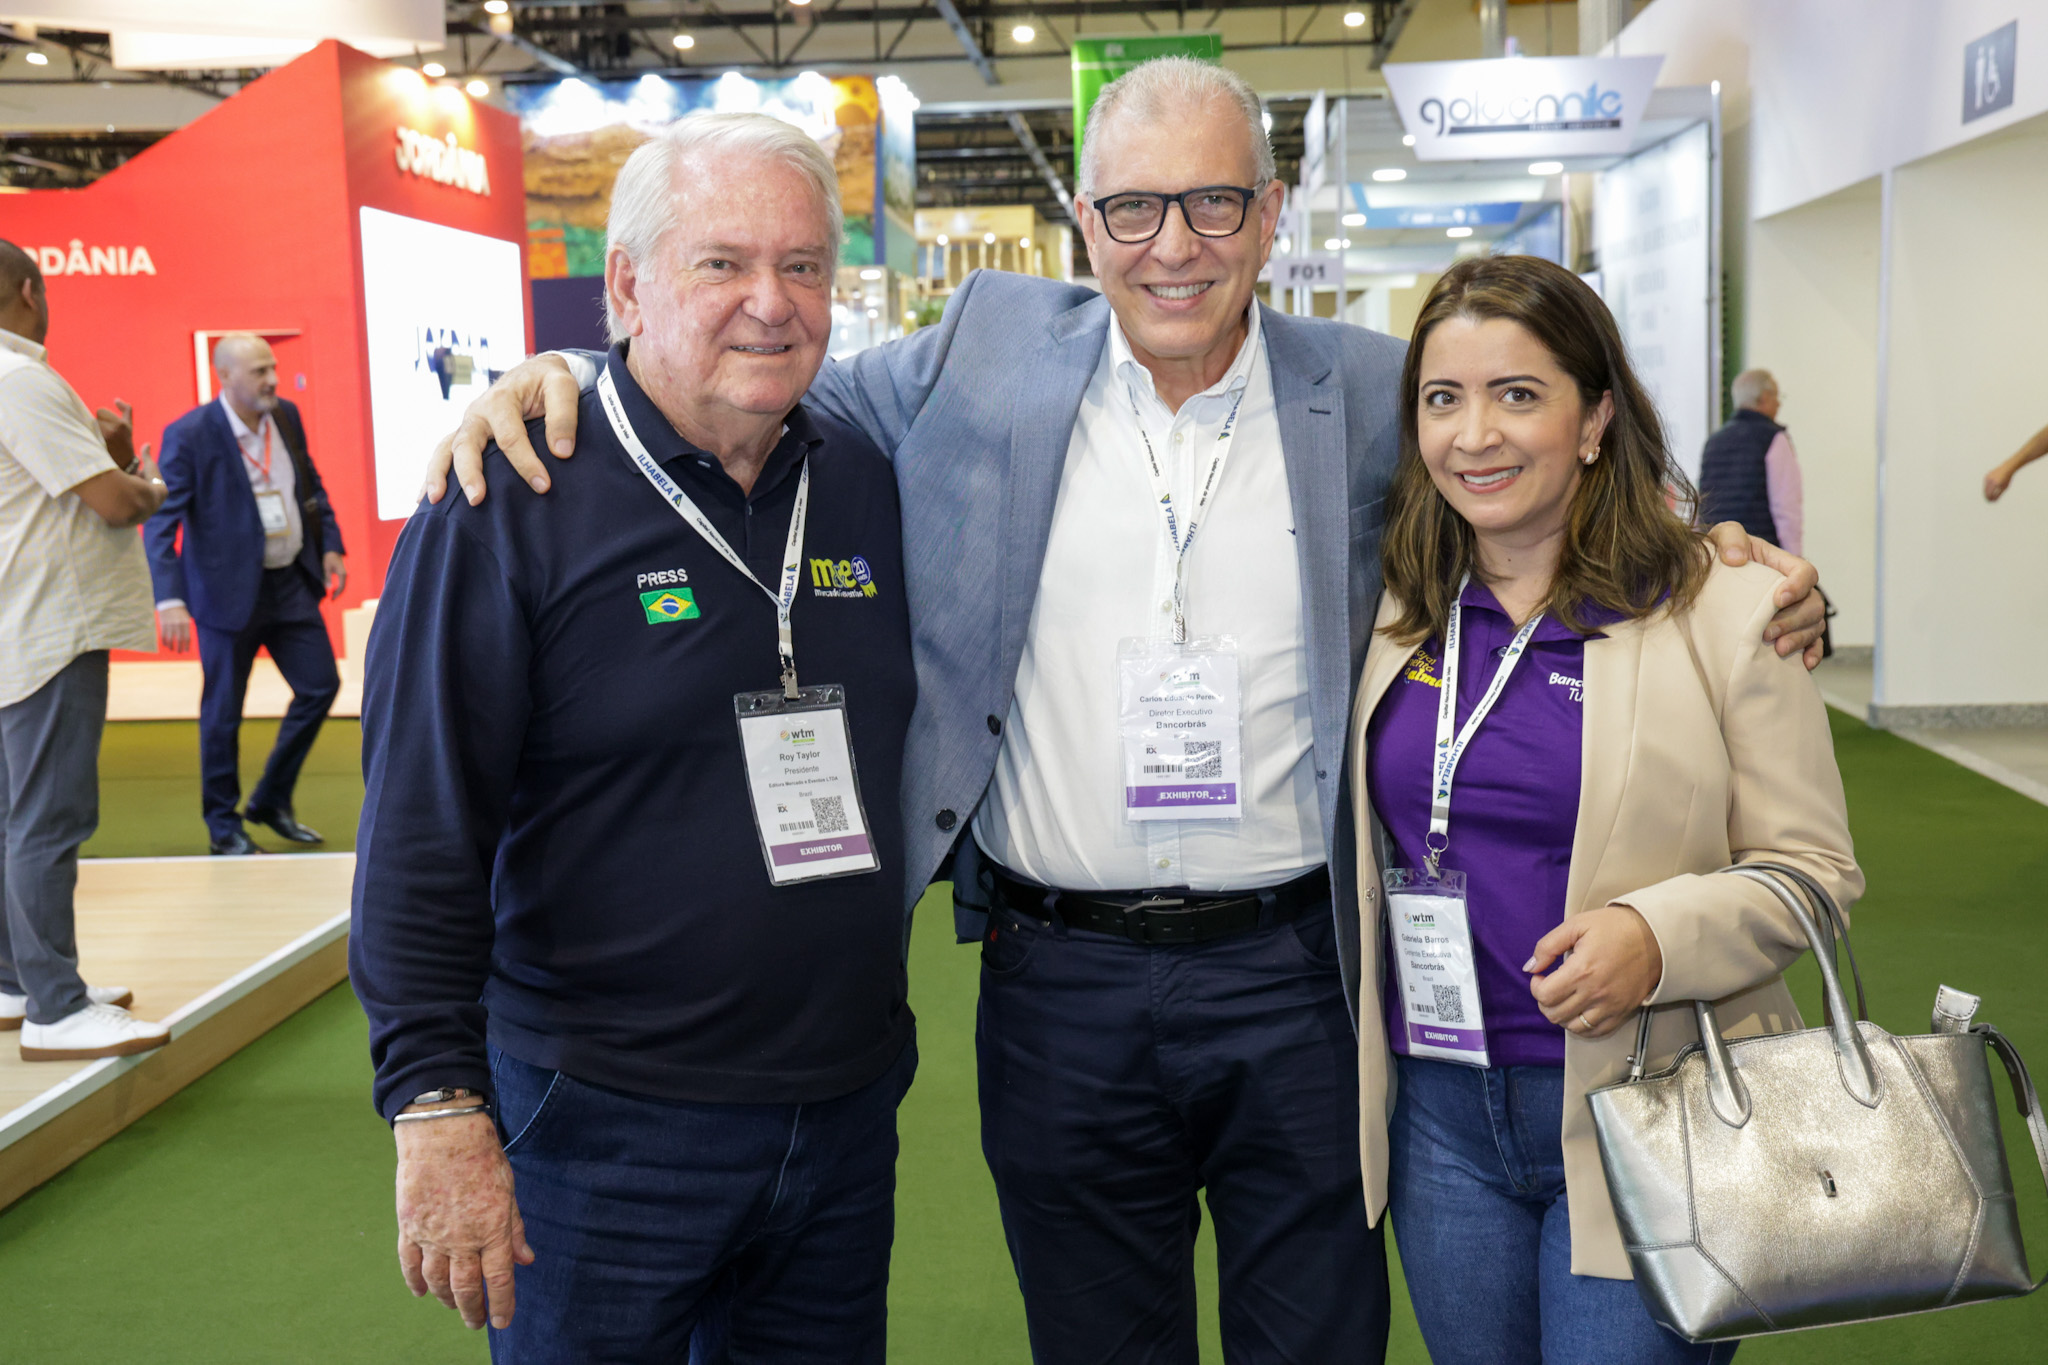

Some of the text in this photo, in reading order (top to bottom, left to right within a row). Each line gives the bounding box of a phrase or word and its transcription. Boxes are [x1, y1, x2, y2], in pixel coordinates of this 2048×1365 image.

[1289, 264, 1326, 280] F01
[637, 453, 674, 496] ILHABELA
[1165, 506, 1180, 552] ILHABELA
[1180, 521, 1198, 556] ILHAB
[636, 568, 688, 589] PRESS
[1448, 604, 1457, 650] ILHABELA
[1549, 672, 1584, 688] Banc
[1139, 695, 1163, 703] Carlos
[1149, 708, 1213, 717] Diretor Executivo
[1156, 720, 1207, 729] Bancorbrás
[791, 728, 815, 739] wtm
[779, 750, 820, 762] Roy Taylor
[1440, 741, 1464, 786] ILHABELA
[784, 765, 820, 775] Presidente
[1160, 790, 1209, 800] EXHIBITOR
[800, 843, 843, 856] EXHIBITOR
[1412, 912, 1435, 923] wtm
[1401, 933, 1450, 944] Gabriela Barros
[1410, 960, 1445, 971] Bancorbrás
[1424, 1031, 1459, 1043] EXHIBITOR
